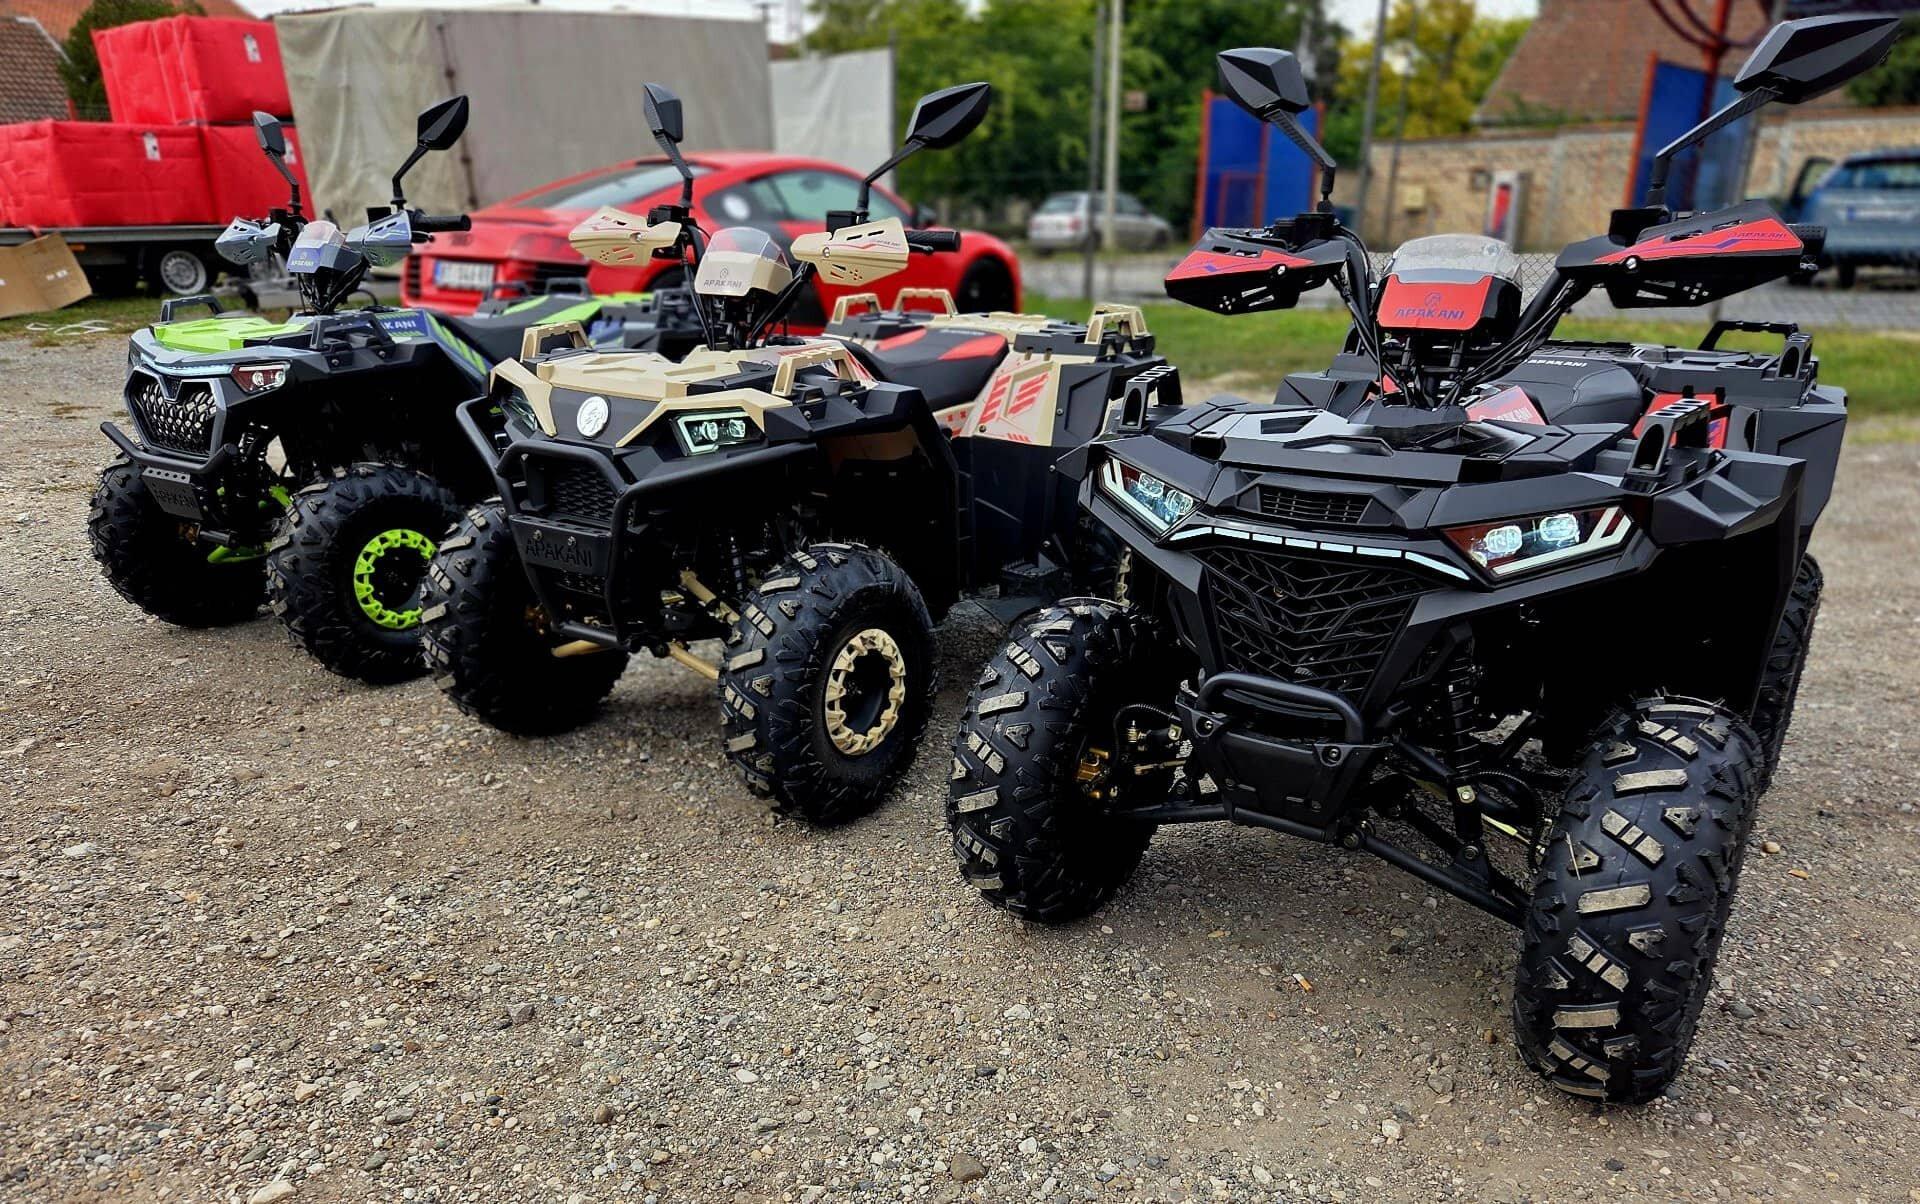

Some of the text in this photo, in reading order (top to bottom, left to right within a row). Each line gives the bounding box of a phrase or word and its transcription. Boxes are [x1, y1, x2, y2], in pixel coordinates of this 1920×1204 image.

[703, 280, 744, 288] APAKANI
[1395, 308, 1465, 319] APAKANI
[381, 320, 417, 330] KANI
[525, 538, 593, 568] APAKANI
